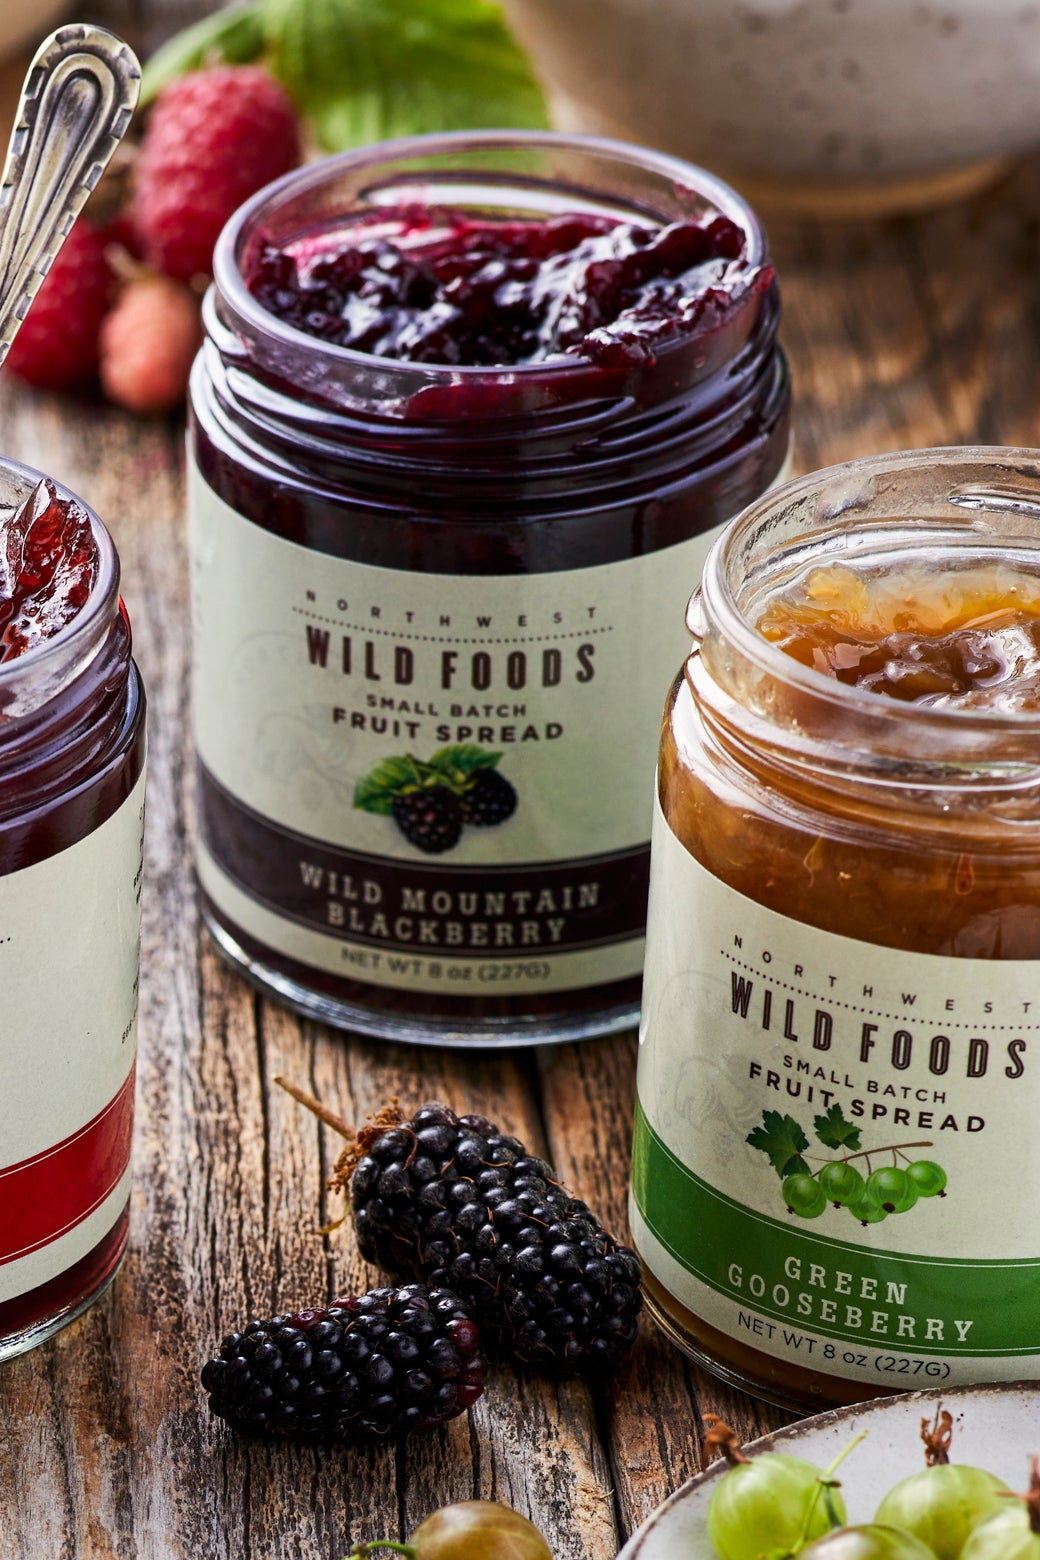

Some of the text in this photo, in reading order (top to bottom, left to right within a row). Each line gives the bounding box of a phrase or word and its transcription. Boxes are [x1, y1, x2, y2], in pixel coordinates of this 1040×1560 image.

[306, 590, 599, 627] NORTHWEST
[306, 624, 415, 686] WILD
[442, 643, 597, 692] FOODS
[332, 709, 565, 743] FRUIT SPREAD
[366, 694, 528, 719] SMALL BATCH
[298, 861, 601, 916] WILD MOUNTAIN
[328, 902, 569, 946] BLACKBERRY
[341, 947, 551, 984] NET WT 8 oz (227G)
[734, 935, 1031, 1013] NORTHWEST
[730, 971, 1027, 1080] WILD FOODS
[749, 1062, 986, 1134] FRUIT SPREAD
[783, 1054, 948, 1105] SMALL BATCH
[728, 1262, 974, 1342] GOOSEBERRY
[784, 1255, 908, 1305] GREEN
[738, 1310, 951, 1380] NET WT 8 oz (227G)
